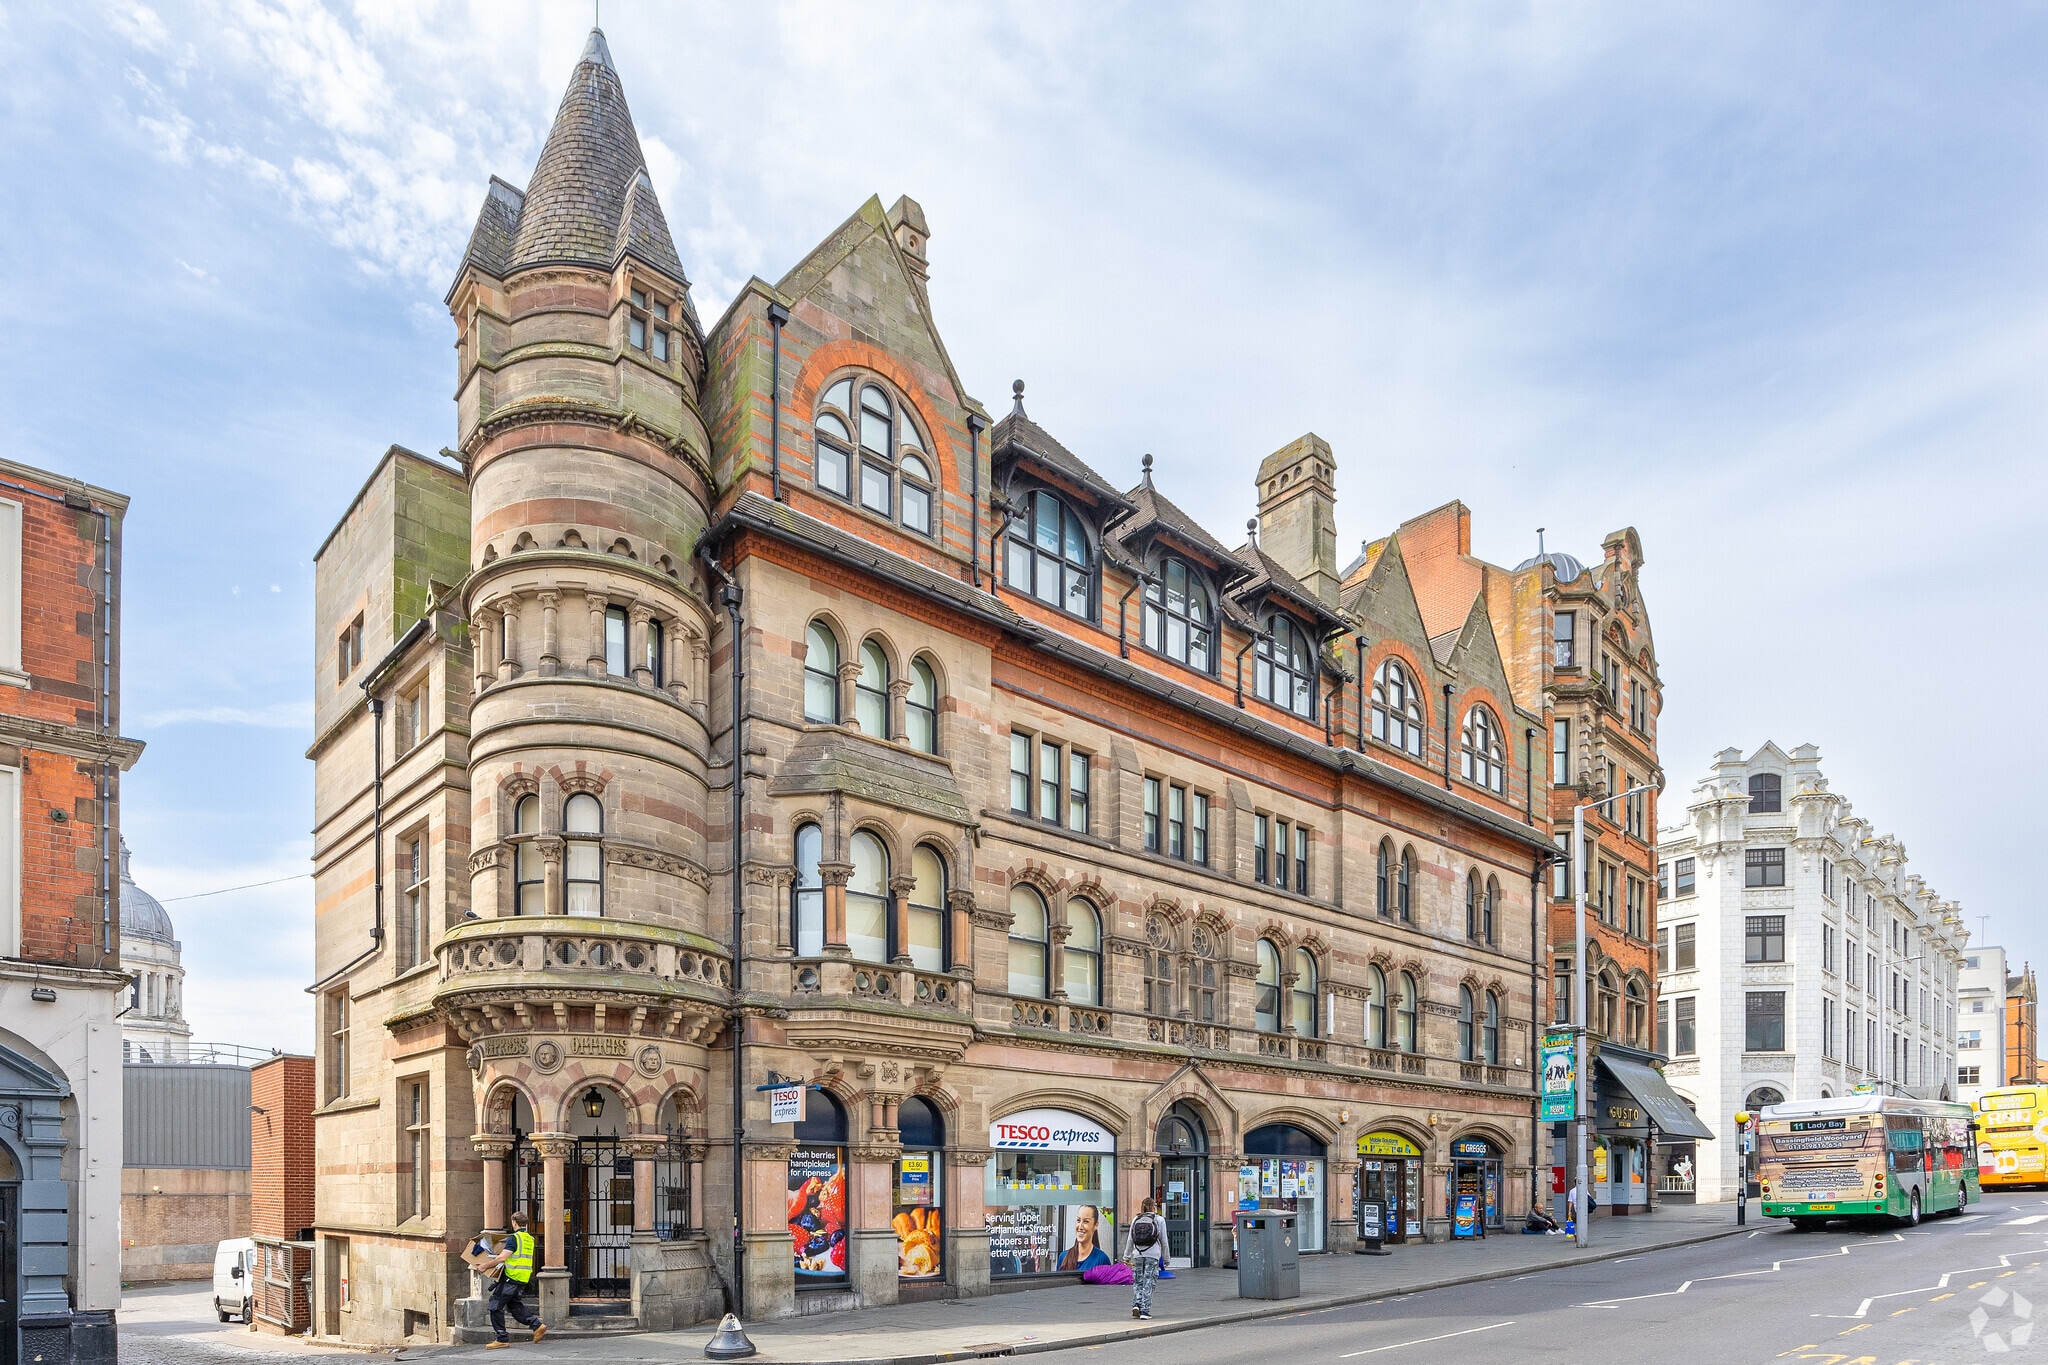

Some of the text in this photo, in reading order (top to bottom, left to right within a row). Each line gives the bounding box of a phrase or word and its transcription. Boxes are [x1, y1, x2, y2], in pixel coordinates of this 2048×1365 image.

[570, 1036, 628, 1056] OFFICES
[773, 1090, 799, 1102] TESCO
[774, 1107, 797, 1118] express
[1611, 1106, 1639, 1121] GUSTO
[1807, 1121, 1826, 1130] Lady
[1828, 1120, 1844, 1128] Bay
[997, 1124, 1100, 1146] TESCO express
[1775, 1134, 1863, 1145] Bassingfield Woodyard
[1465, 1143, 1487, 1153] GREGGS
[790, 1151, 836, 1159] Fresh berries
[790, 1160, 830, 1169] handpicked
[802, 1169, 832, 1178] ripeness
[985, 1212, 1041, 1224] Serving Upper
[985, 1224, 1057, 1234] Parliament Street's
[989, 1236, 1047, 1247] hoppers a little
[991, 1247, 1050, 1258] etter every day
